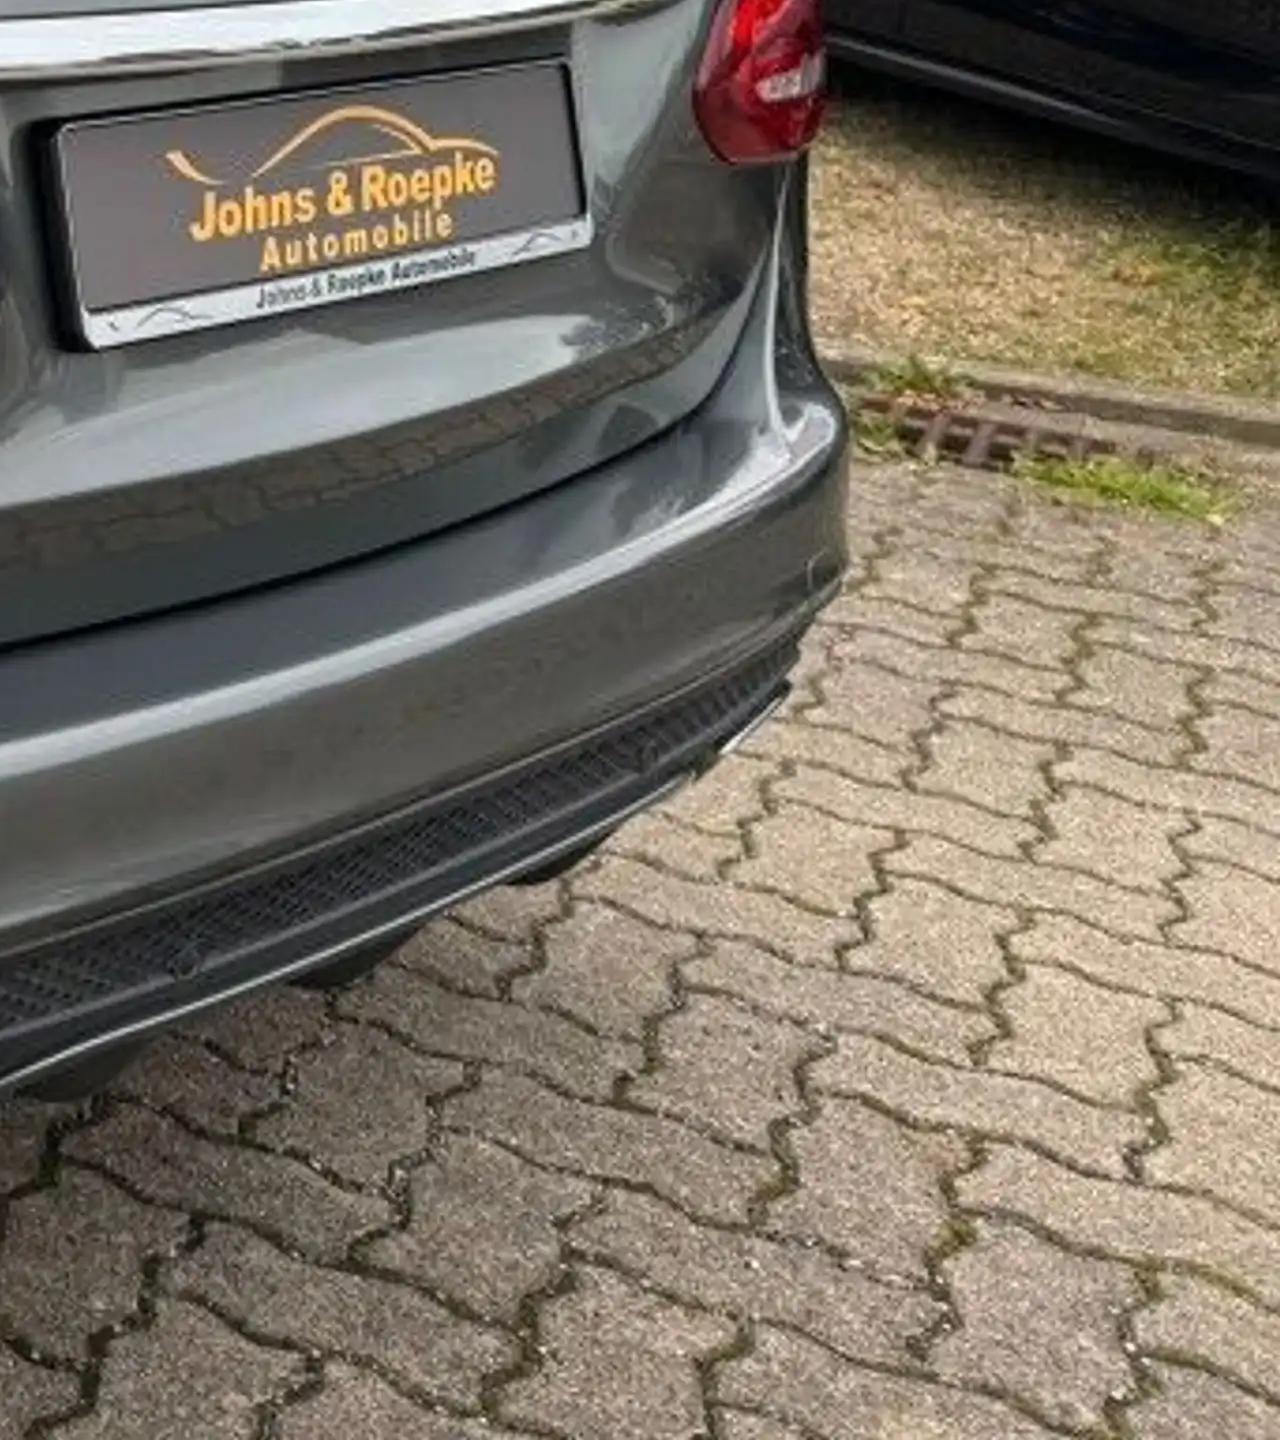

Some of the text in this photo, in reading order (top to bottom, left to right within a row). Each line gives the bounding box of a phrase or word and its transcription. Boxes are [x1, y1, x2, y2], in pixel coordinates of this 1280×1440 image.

[190, 152, 496, 242] Johns & Roepke
[259, 211, 452, 273] Automobile
